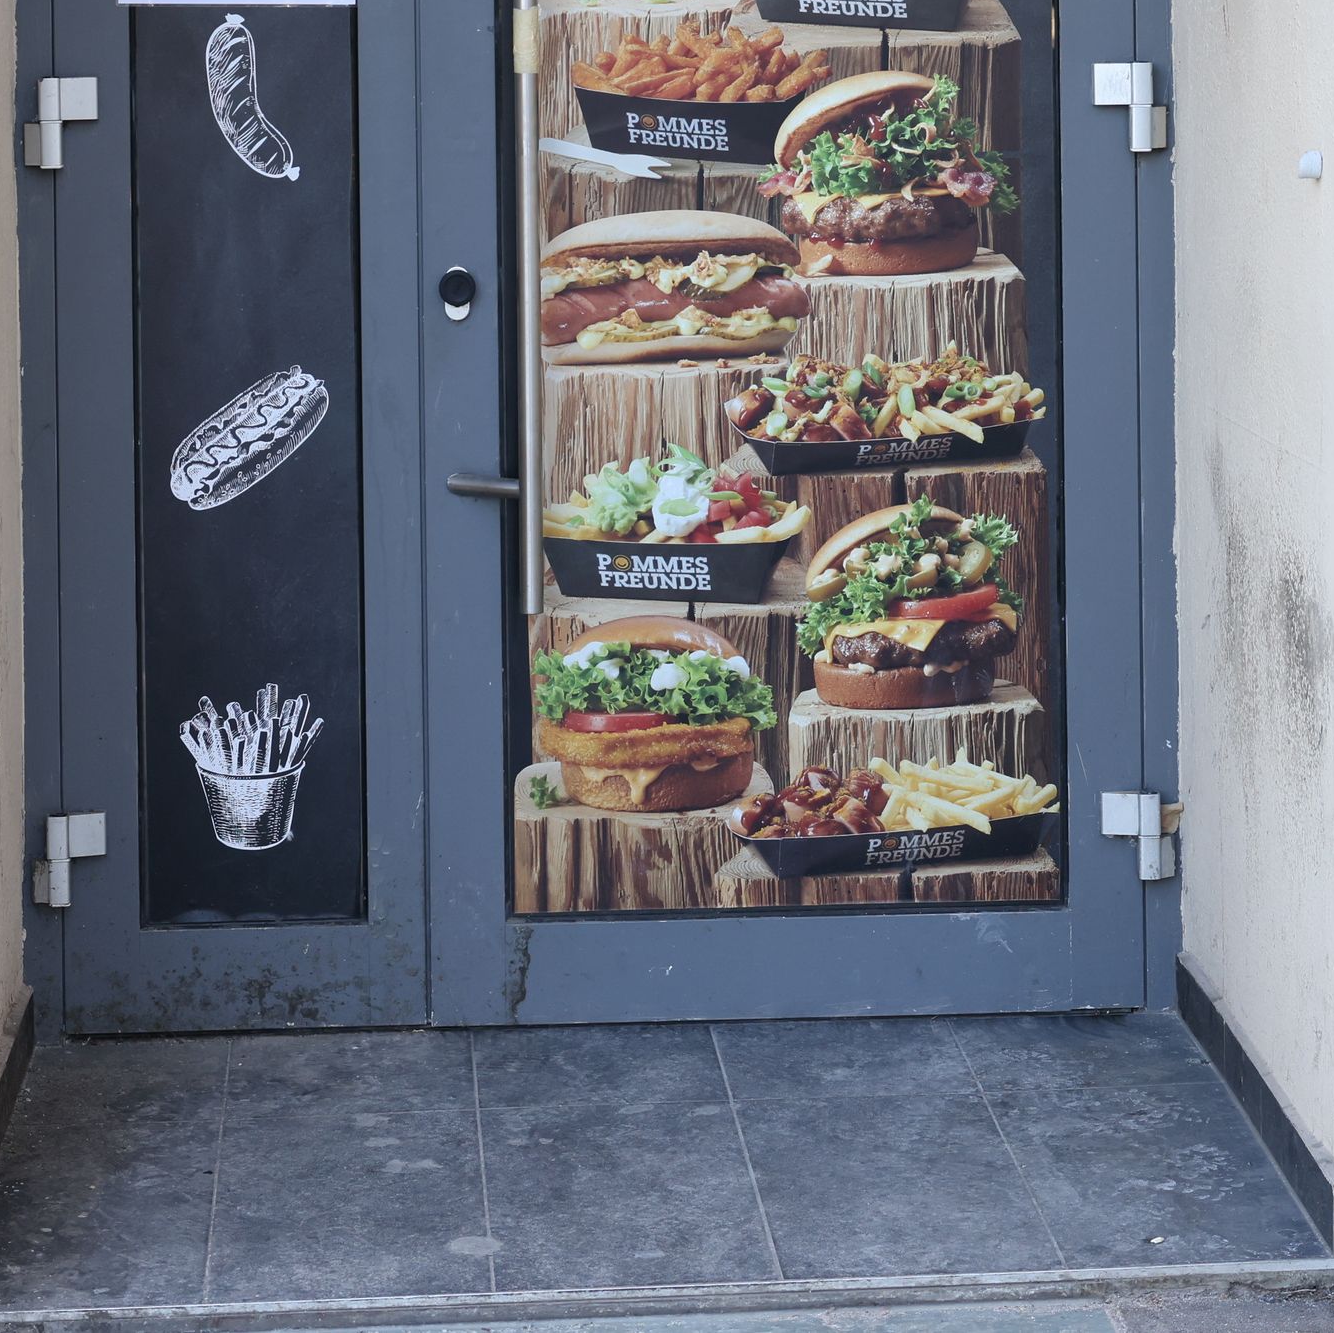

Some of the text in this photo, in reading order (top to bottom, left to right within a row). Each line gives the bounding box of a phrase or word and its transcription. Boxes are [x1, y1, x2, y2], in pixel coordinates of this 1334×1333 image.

[797, 0, 908, 18] FREUNDE
[627, 112, 726, 134] POMMES
[628, 129, 729, 151] FREUNDE
[854, 449, 950, 466] FREUNDE
[597, 553, 708, 573] POMMES
[599, 572, 711, 591] FREUNDE
[866, 830, 965, 853] POMMES
[865, 844, 963, 865] FREUNDE
